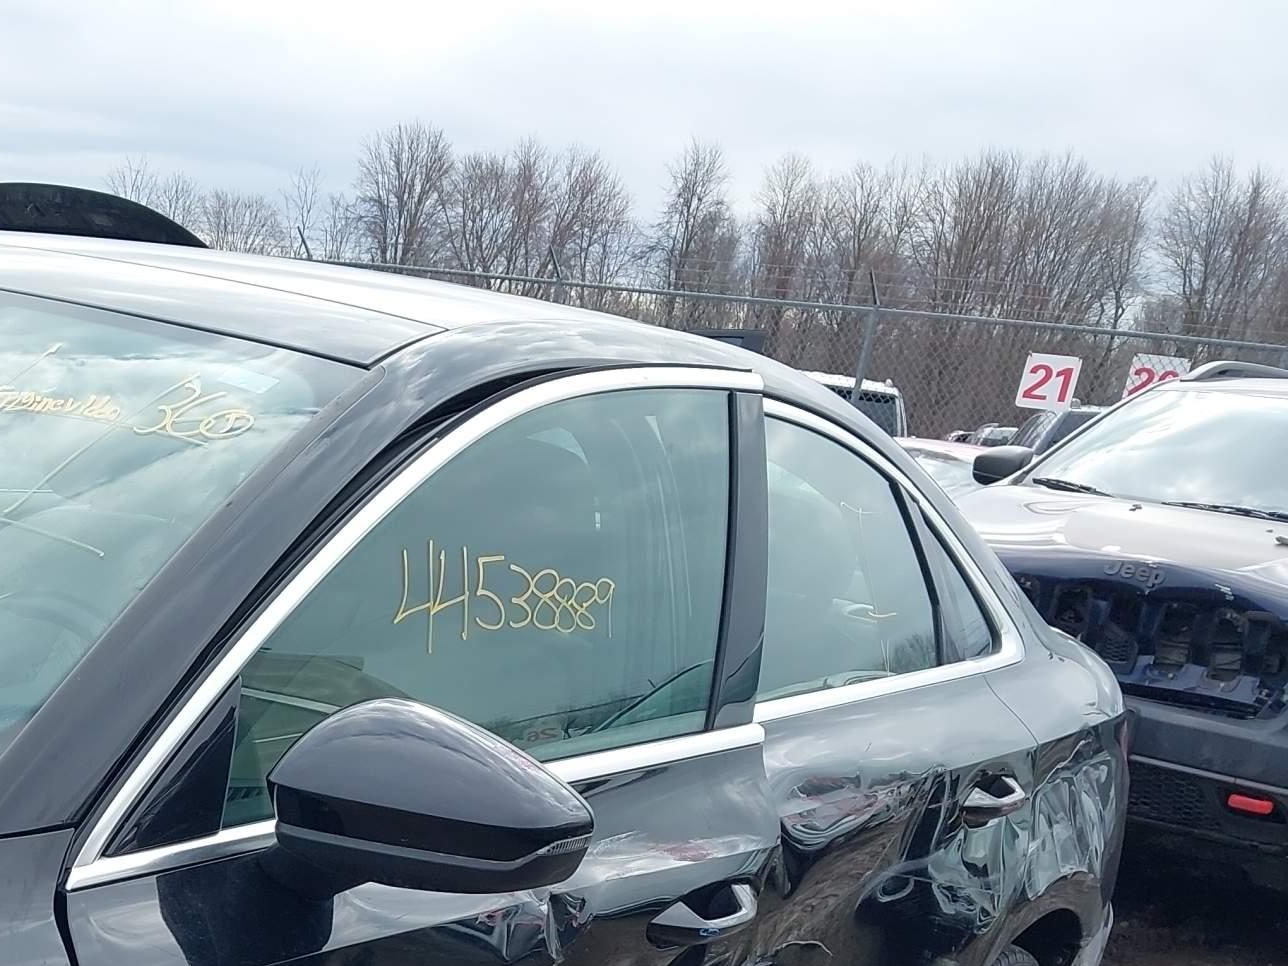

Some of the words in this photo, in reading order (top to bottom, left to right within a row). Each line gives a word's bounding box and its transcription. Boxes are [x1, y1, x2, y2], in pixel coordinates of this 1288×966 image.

[1022, 364, 1075, 403] 21
[1103, 559, 1168, 588] Jeep
[393, 539, 616, 654] 44538889
